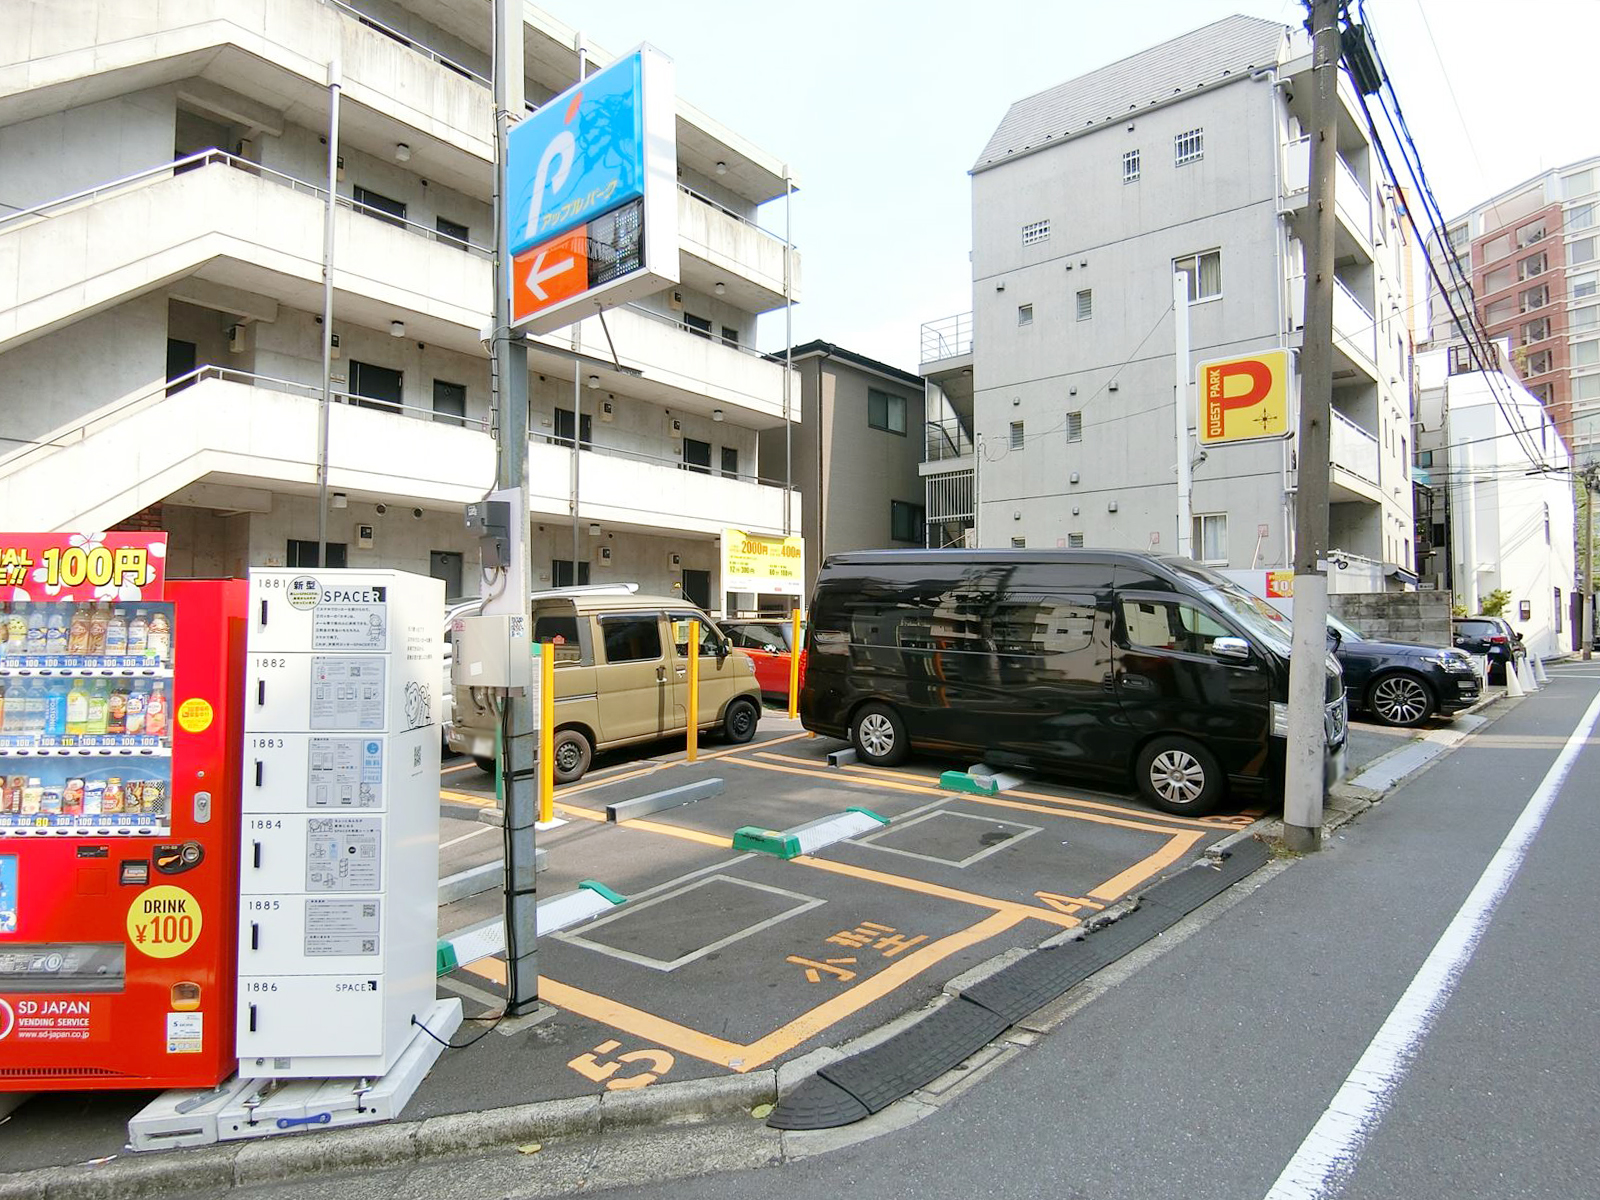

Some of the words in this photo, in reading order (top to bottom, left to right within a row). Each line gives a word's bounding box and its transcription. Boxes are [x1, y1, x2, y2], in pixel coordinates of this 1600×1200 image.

[541, 177, 618, 230] アップルパーク
[1210, 369, 1221, 398] PARK
[1206, 360, 1272, 438] P
[1210, 402, 1221, 436] QUEST
[741, 540, 769, 556] 2000円
[781, 545, 801, 558] 400円
[0, 548, 33, 566] AL
[43, 547, 148, 587] 100円
[258, 578, 287, 588] 1881
[293, 580, 316, 590] 新型
[6, 659, 19, 667] 100
[26, 659, 38, 667] 100
[45, 659, 58, 667] 100
[64, 659, 77, 667] 100
[84, 659, 97, 667] 100
[103, 659, 116, 667] 100
[123, 659, 136, 667] 100
[142, 659, 155, 667] 100
[256, 659, 286, 668] 1882
[42, 738, 55, 746] 100
[83, 738, 96, 746] 100
[102, 738, 115, 746] 100
[122, 738, 134, 746] 100
[141, 738, 154, 746] 100
[252, 739, 284, 748] 1883
[79, 817, 92, 825] 100
[98, 817, 111, 825] 100
[118, 817, 131, 825] 100
[137, 817, 150, 825] 100
[251, 820, 282, 829] 1884
[143, 899, 187, 914] DRINK
[249, 901, 280, 910] 1885
[1034, 891, 1105, 914] 4
[135, 915, 194, 944] ¥100
[786, 921, 930, 984] 小型
[247, 982, 278, 992] 1886
[18, 1001, 38, 1014] SD
[41, 1001, 90, 1014] JAPAN
[18, 1018, 55, 1026] VENDING
[57, 1018, 90, 1026] SERVICE
[18, 1031, 90, 1039] www.sd-japan.co.jp
[567, 1039, 675, 1091] 5
